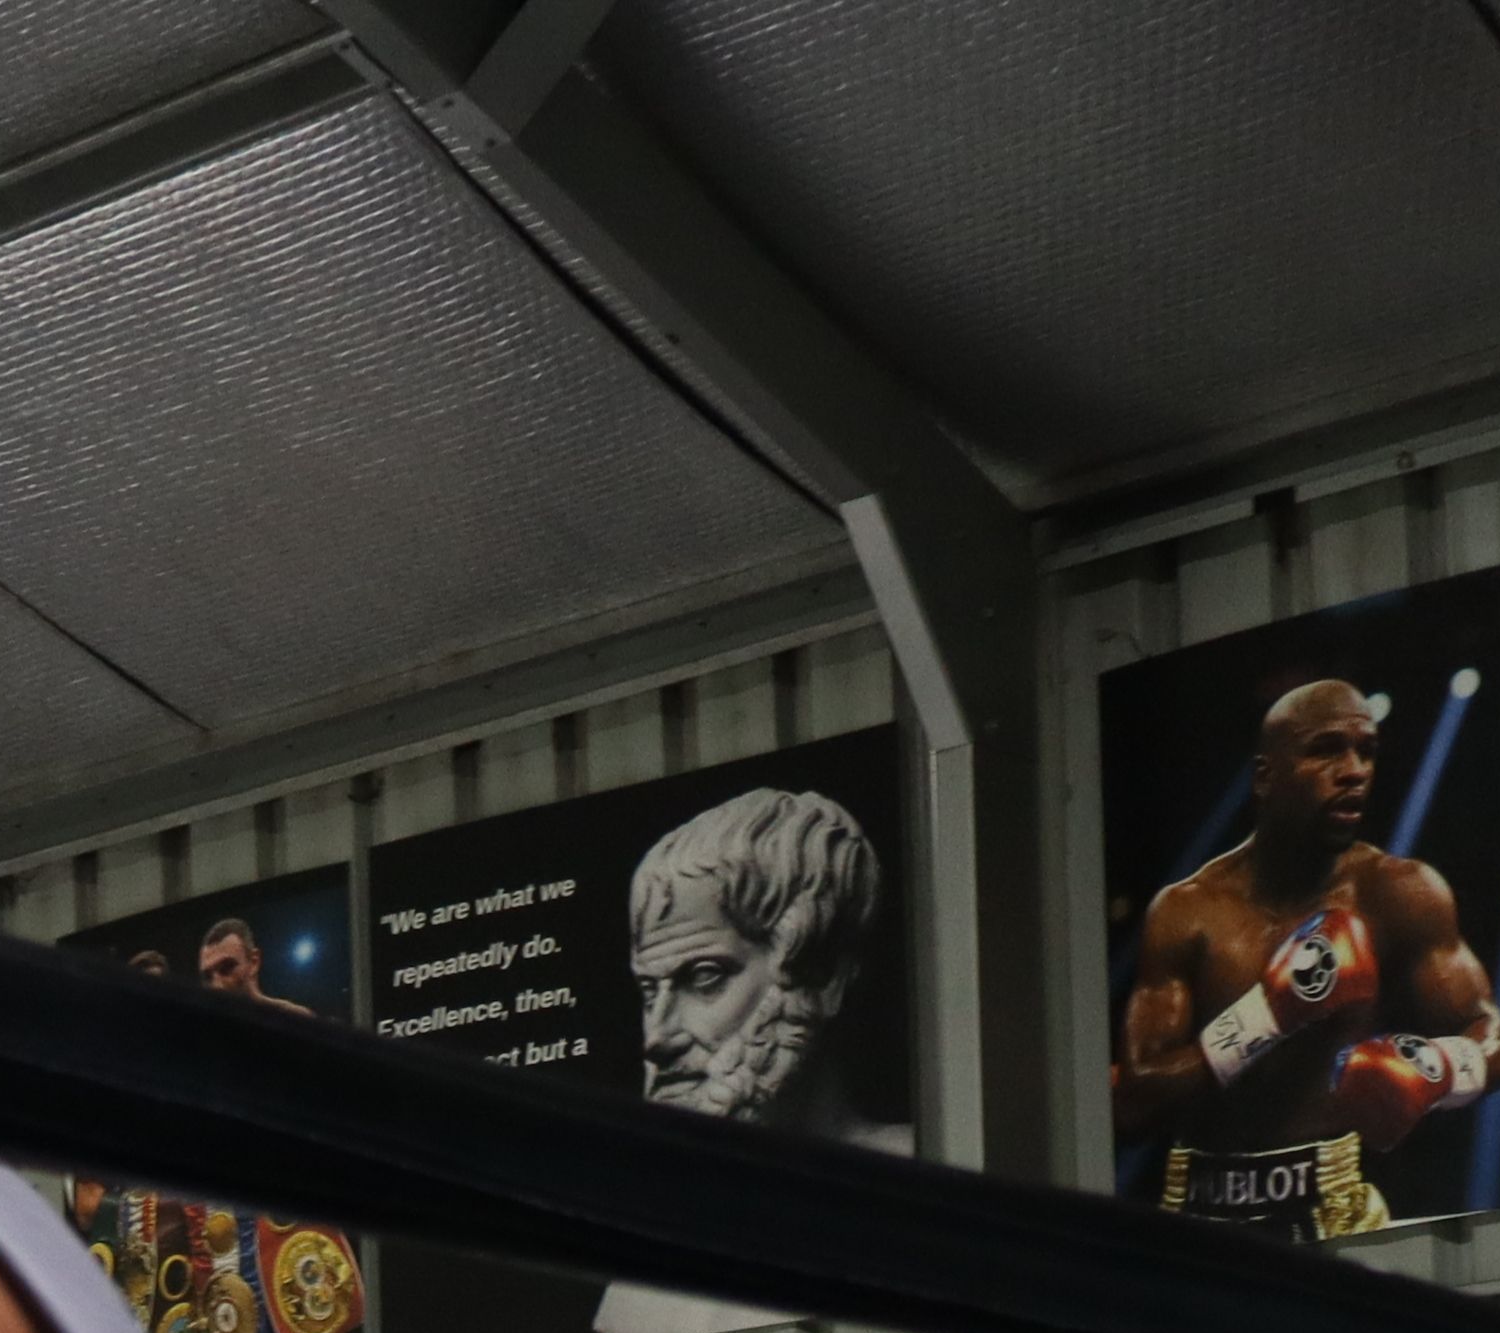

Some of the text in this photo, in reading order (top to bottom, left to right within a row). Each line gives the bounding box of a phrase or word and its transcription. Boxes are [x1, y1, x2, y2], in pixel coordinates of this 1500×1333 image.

[430, 901, 470, 926] are
[475, 883, 535, 916] what
[539, 878, 577, 902] we
[392, 933, 562, 989] repeatedly do.
[377, 987, 578, 1039] Excellence, then,
[524, 1038, 568, 1066] but
[570, 1037, 590, 1057] a
